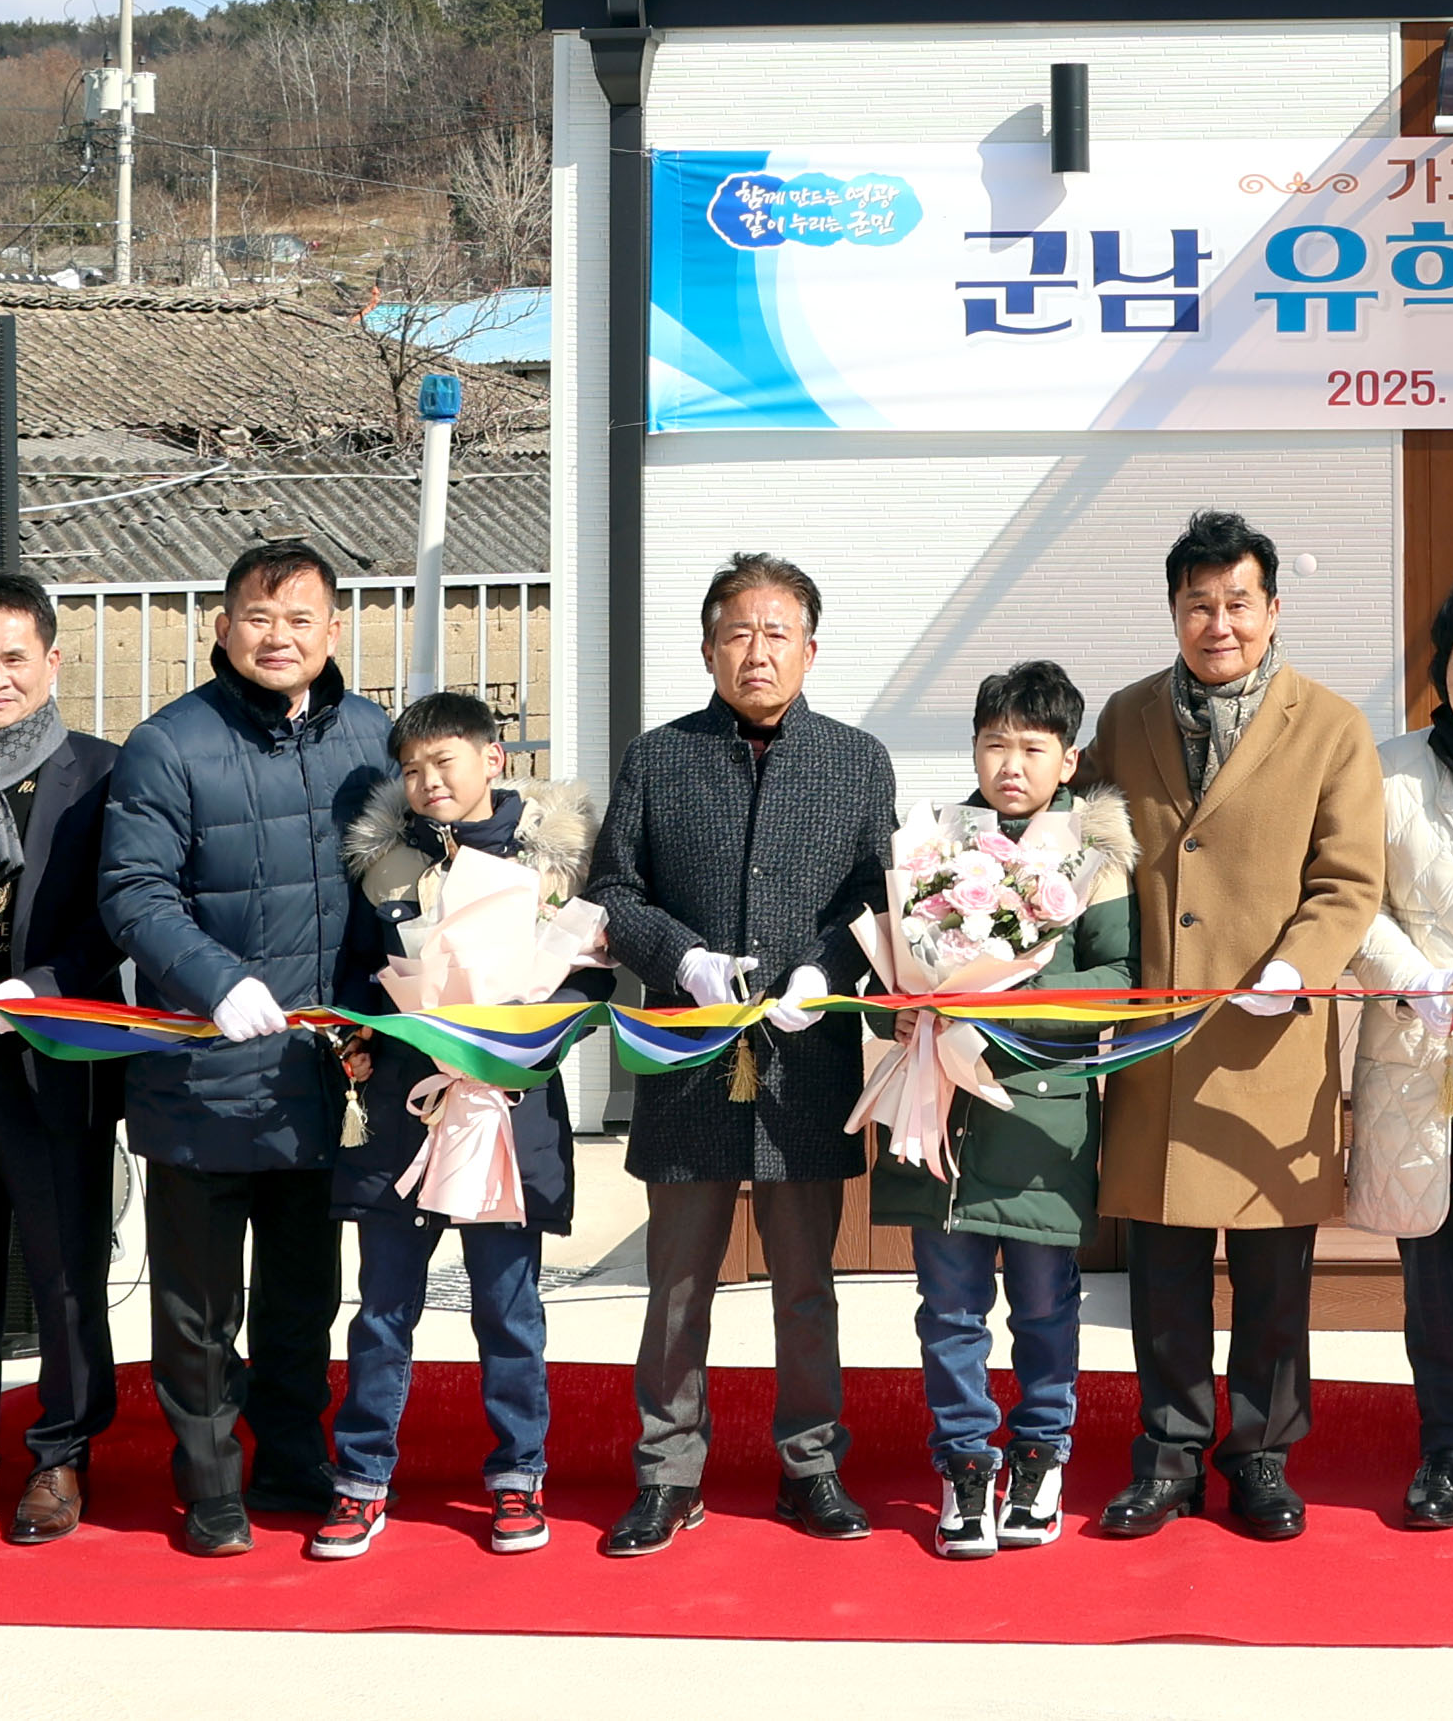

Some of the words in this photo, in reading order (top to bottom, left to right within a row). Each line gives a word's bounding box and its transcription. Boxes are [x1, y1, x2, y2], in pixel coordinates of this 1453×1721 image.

[735, 181, 787, 210] 함께
[789, 187, 843, 208] 만드는
[845, 183, 900, 209] 영광
[739, 210, 786, 238] 같이
[789, 213, 844, 235] 누리는
[847, 210, 895, 238] 군민
[955, 228, 1212, 336] 군남
[1327, 369, 1446, 406] 2025.
